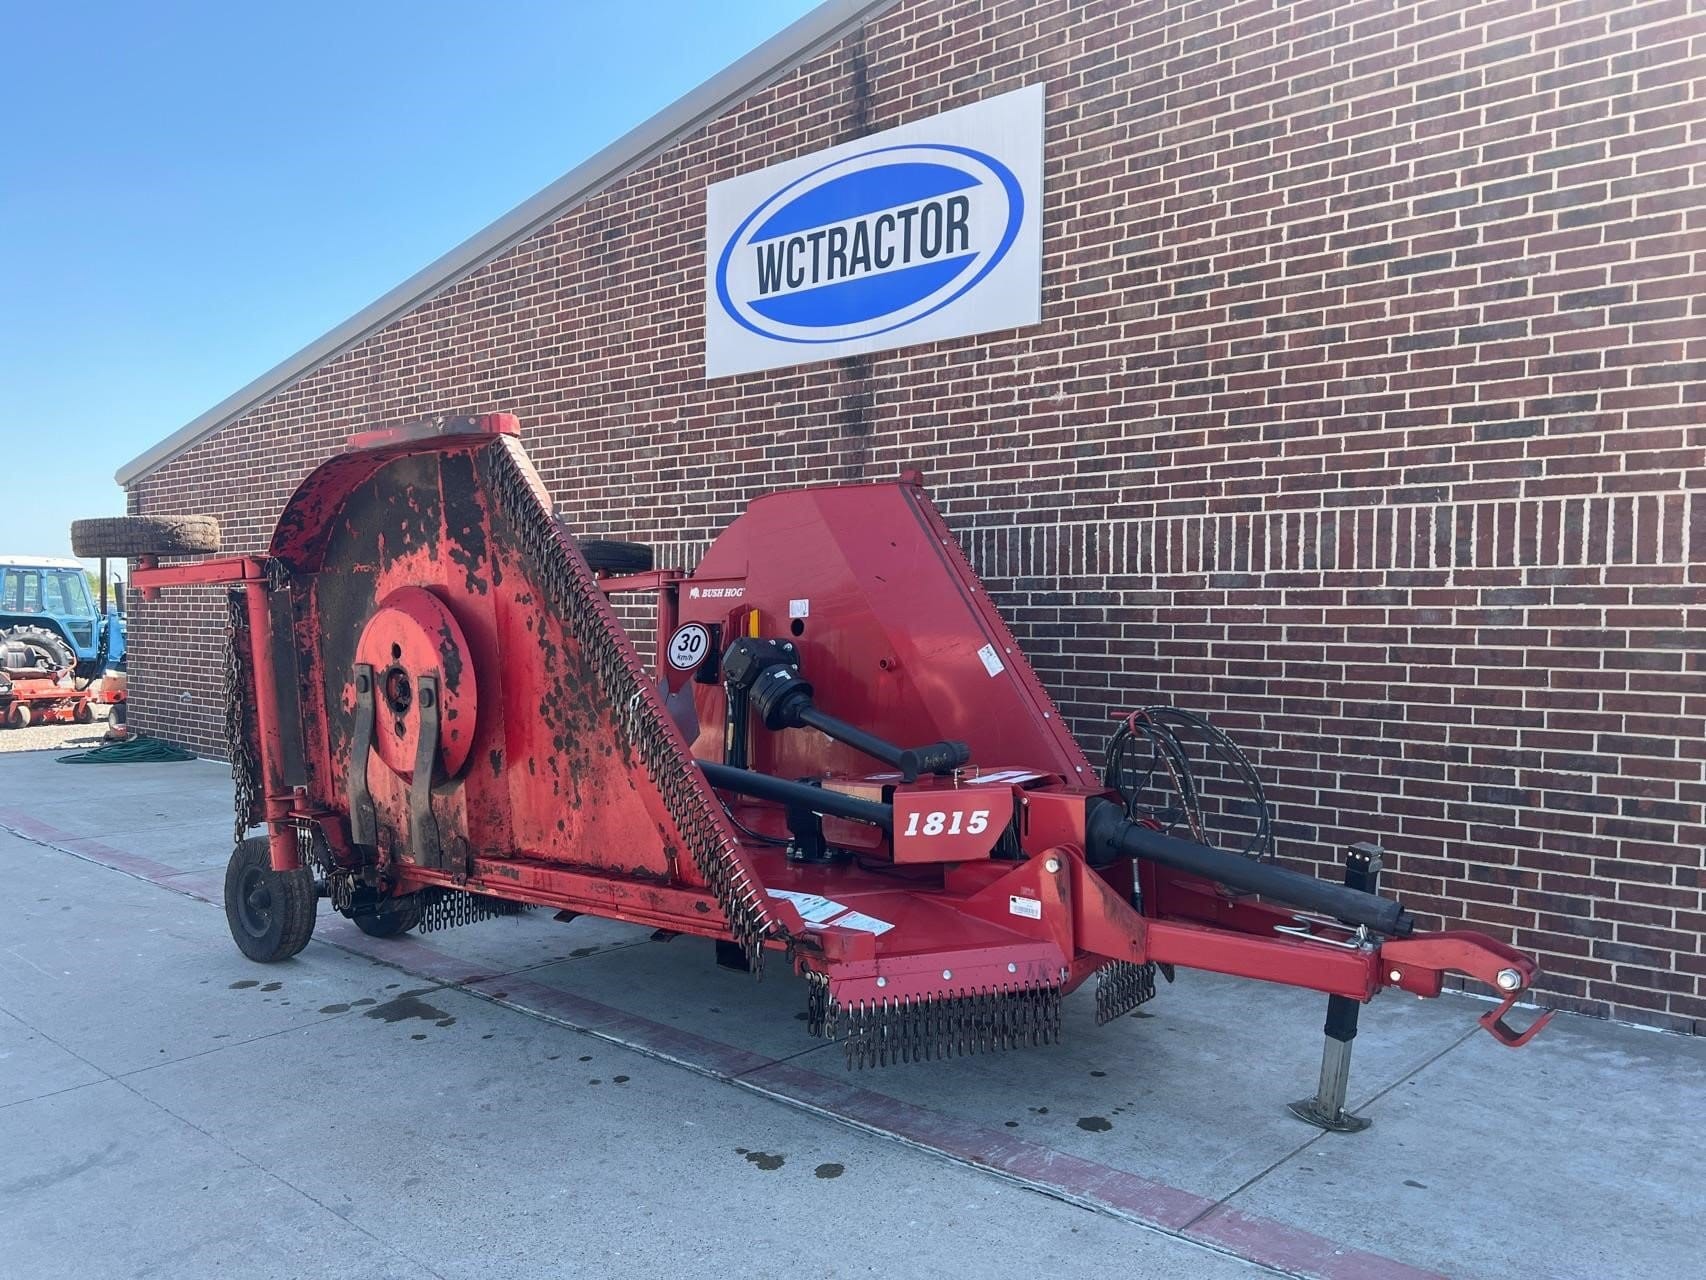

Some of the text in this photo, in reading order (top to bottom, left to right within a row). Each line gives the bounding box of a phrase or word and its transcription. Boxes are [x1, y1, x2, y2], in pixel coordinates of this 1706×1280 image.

[757, 195, 970, 295] WCTRACTOR
[702, 587, 744, 598] BUSH HOG
[678, 634, 701, 653] 30
[677, 654, 694, 662] km/h
[904, 810, 990, 836] 1815
